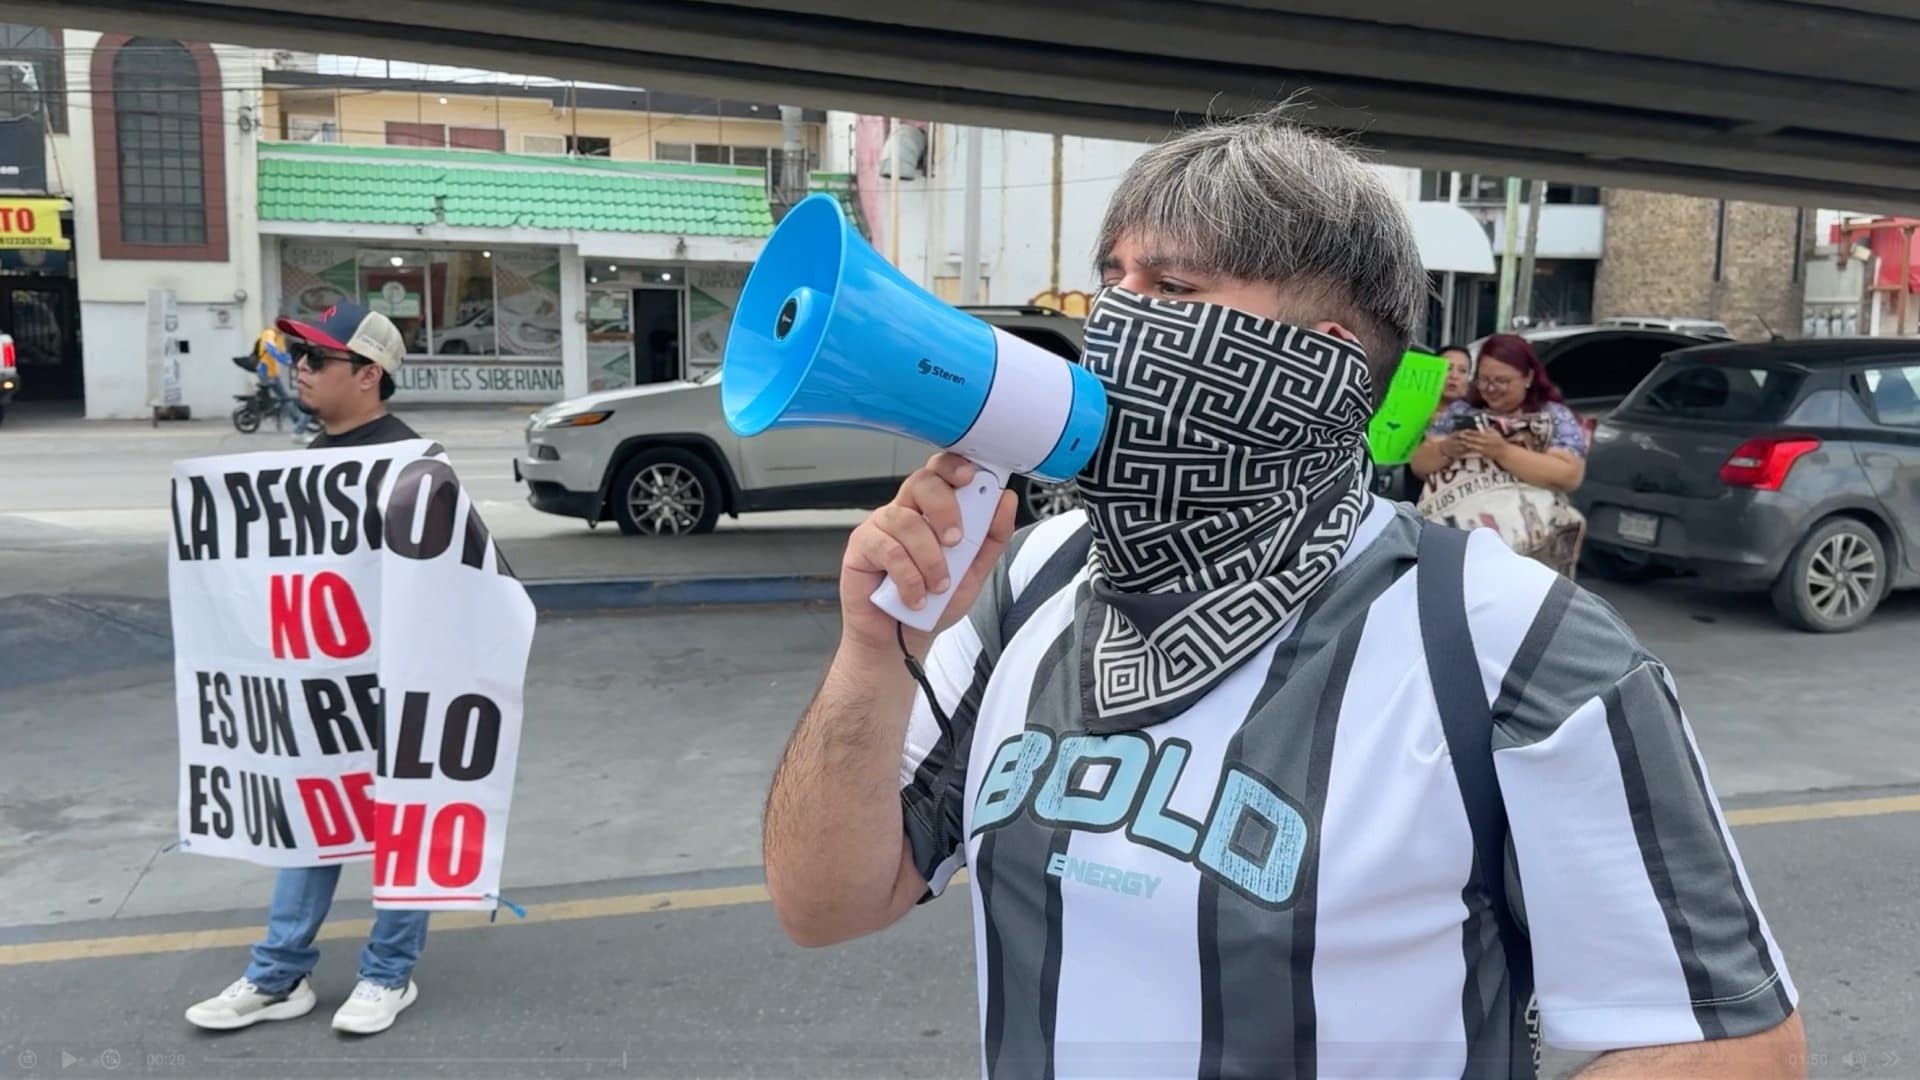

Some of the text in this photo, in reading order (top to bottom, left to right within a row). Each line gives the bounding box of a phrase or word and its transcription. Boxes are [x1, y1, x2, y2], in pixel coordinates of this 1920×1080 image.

[0, 207, 35, 233] TO
[475, 367, 563, 391] SIBERIANA
[931, 366, 965, 384] Steren
[171, 476, 219, 561] LA
[270, 571, 372, 660] NO
[196, 671, 239, 750] ES
[240, 674, 300, 758] UN
[189, 764, 234, 840] ES
[239, 771, 297, 850] UN
[970, 722, 1314, 912] BOLD
[1046, 852, 1162, 899] ENERGY
